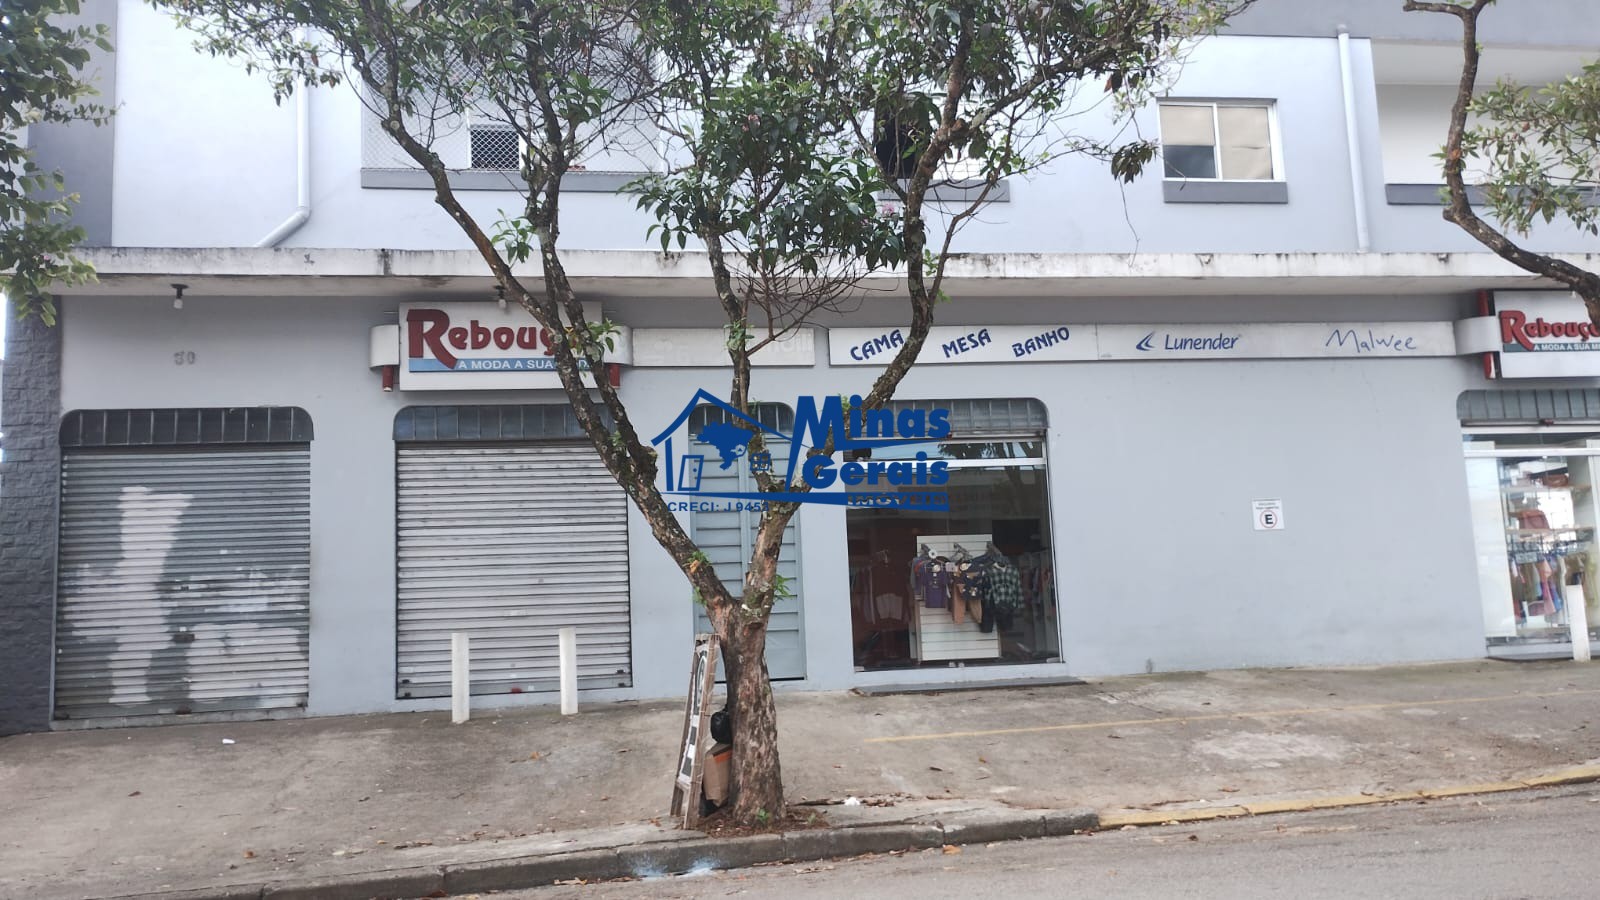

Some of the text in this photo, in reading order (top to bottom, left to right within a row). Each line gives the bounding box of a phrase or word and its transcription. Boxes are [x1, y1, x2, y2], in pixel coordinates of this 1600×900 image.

[850, 329, 904, 361] CAMA
[942, 328, 992, 358] MESA
[1012, 326, 1070, 358] BANHO
[1164, 334, 1239, 351] Lunender
[1325, 328, 1418, 353] Malwee
[1534, 343, 1540, 351] A
[1541, 343, 1566, 351] MODA
[1566, 343, 1573, 351] A
[1573, 343, 1590, 351] SUA
[458, 359, 554, 370] A MODA A SUA
[1264, 513, 1274, 525] E
